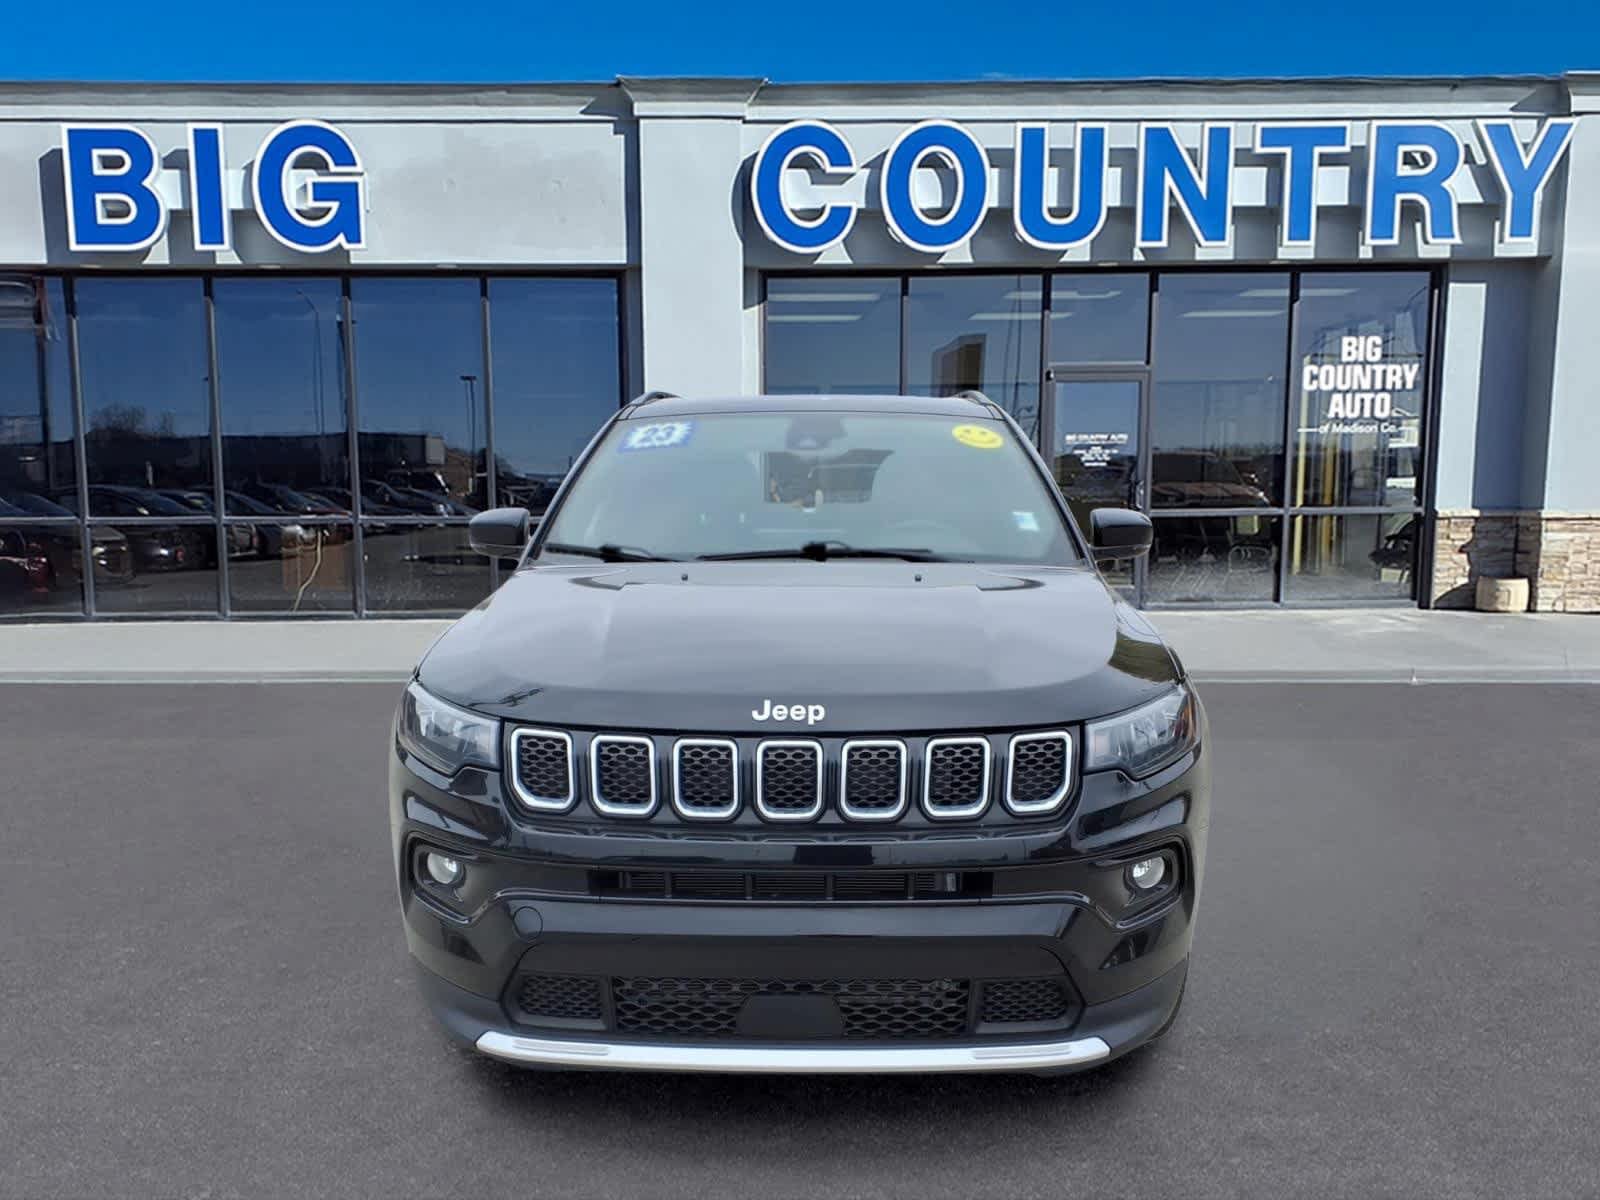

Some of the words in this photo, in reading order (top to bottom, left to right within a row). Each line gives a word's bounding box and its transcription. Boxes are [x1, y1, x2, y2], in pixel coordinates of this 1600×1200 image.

[61, 119, 366, 253] BIG
[750, 117, 1575, 255] COUNTRY
[1341, 335, 1382, 362] BIG
[1302, 363, 1420, 391] COUNTRY
[1327, 392, 1391, 419] AUTO
[752, 699, 825, 725] Jeep
